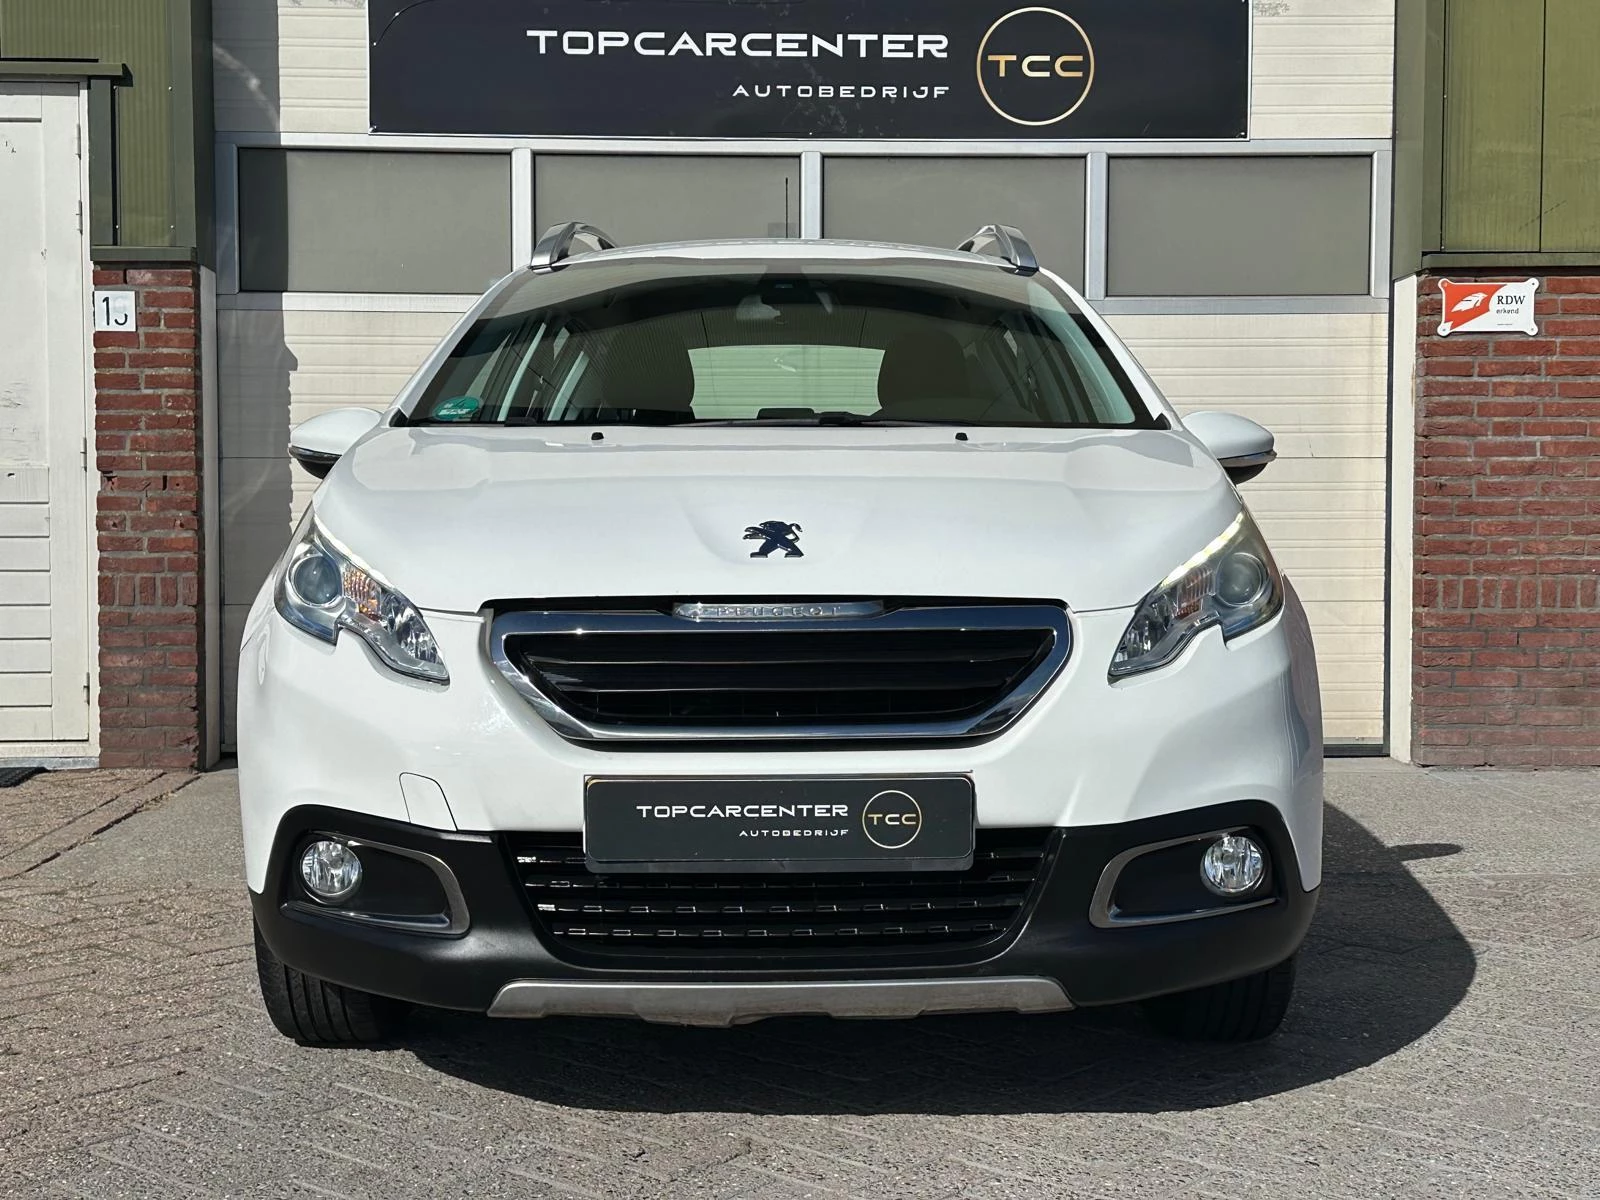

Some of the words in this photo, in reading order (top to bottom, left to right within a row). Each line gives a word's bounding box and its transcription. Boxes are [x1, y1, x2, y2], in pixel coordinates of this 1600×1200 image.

[526, 29, 949, 59] TOPCARCENTER
[987, 54, 1084, 78] TCC
[732, 84, 950, 99] AUTOBEDRIJF
[1496, 295, 1525, 305] RDW
[1496, 307, 1520, 315] erkend
[716, 605, 842, 618] PEUGEOT
[635, 804, 849, 818] TOPCARCENTER
[867, 813, 917, 826] TCC
[738, 829, 849, 837] AUTOBEDRIJF
